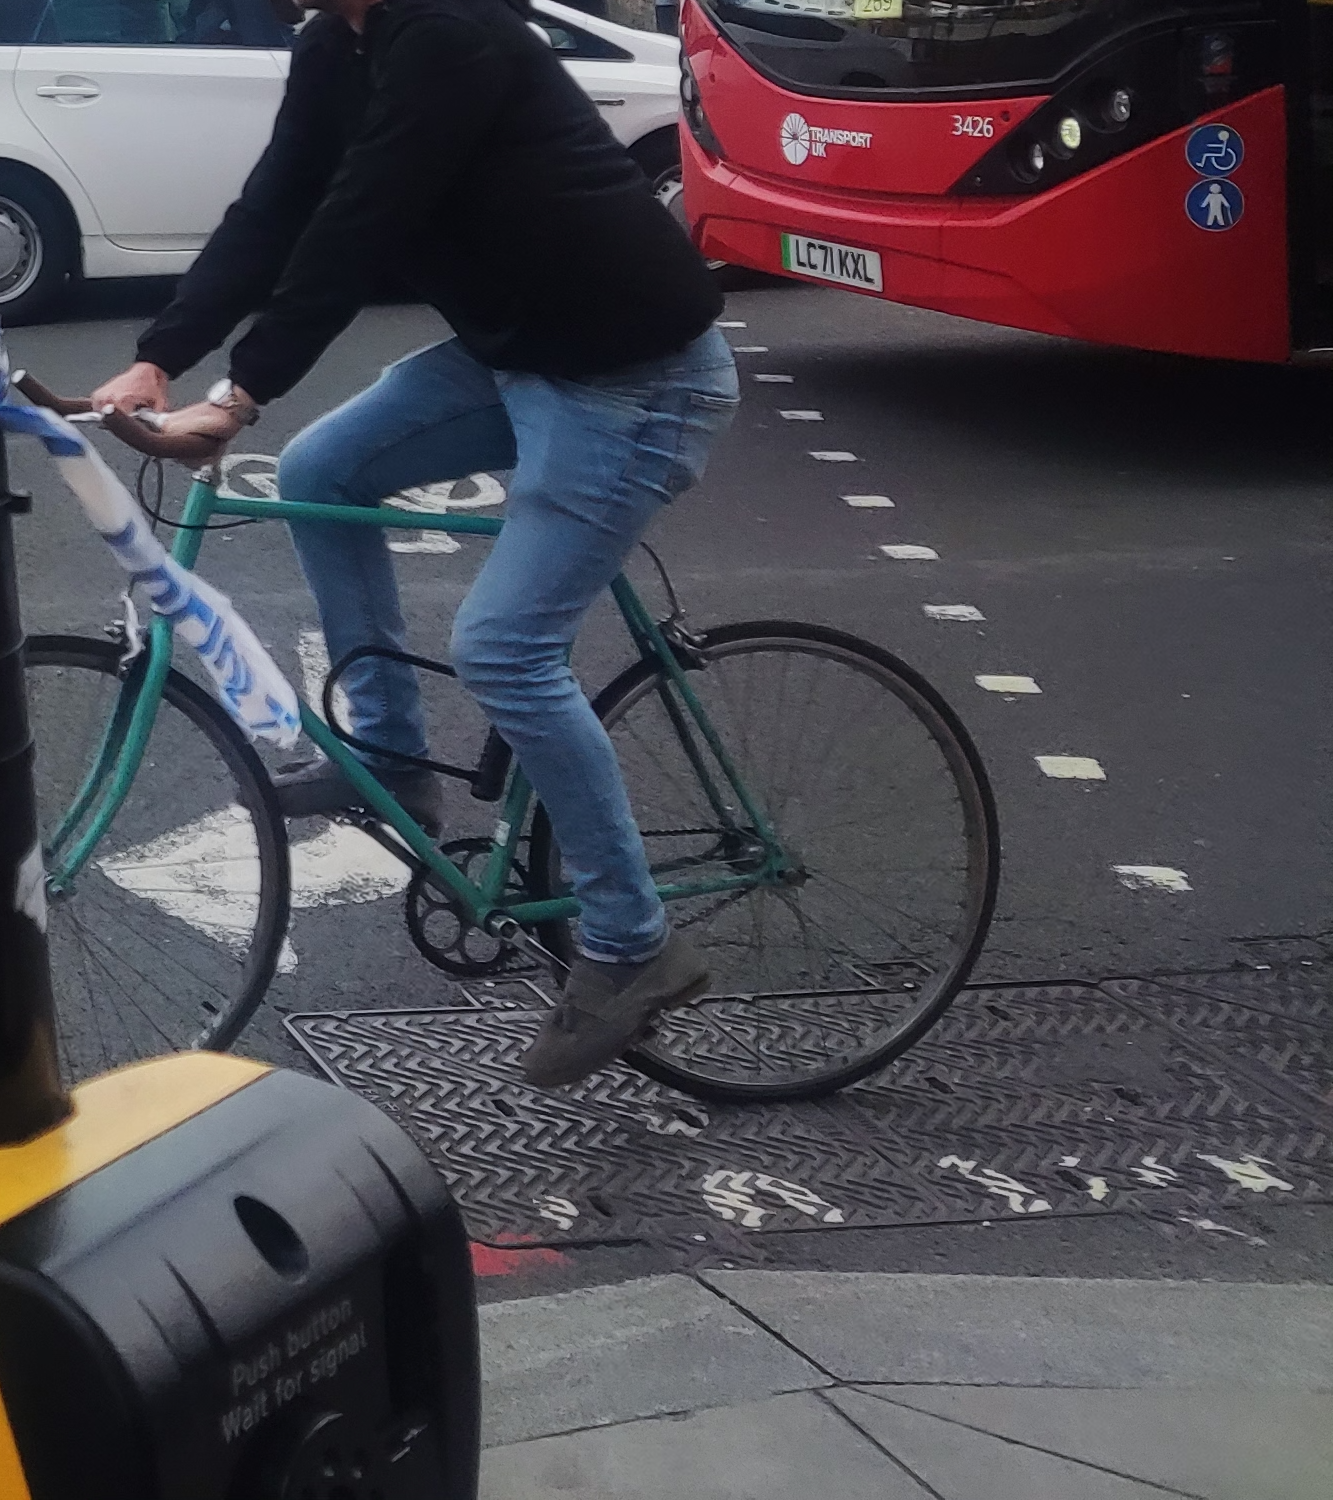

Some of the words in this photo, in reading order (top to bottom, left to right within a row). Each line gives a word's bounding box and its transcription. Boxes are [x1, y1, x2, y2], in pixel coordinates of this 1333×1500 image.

[808, 126, 873, 149] TRANSPORT
[950, 114, 994, 138] 3426
[811, 142, 828, 158] UK
[795, 239, 836, 275] LC71
[838, 248, 875, 284] KXL
[232, 1342, 281, 1397] Push
[287, 1299, 353, 1358] button
[221, 1388, 270, 1444] Wait
[275, 1370, 304, 1407] for
[310, 1320, 368, 1384] signal
